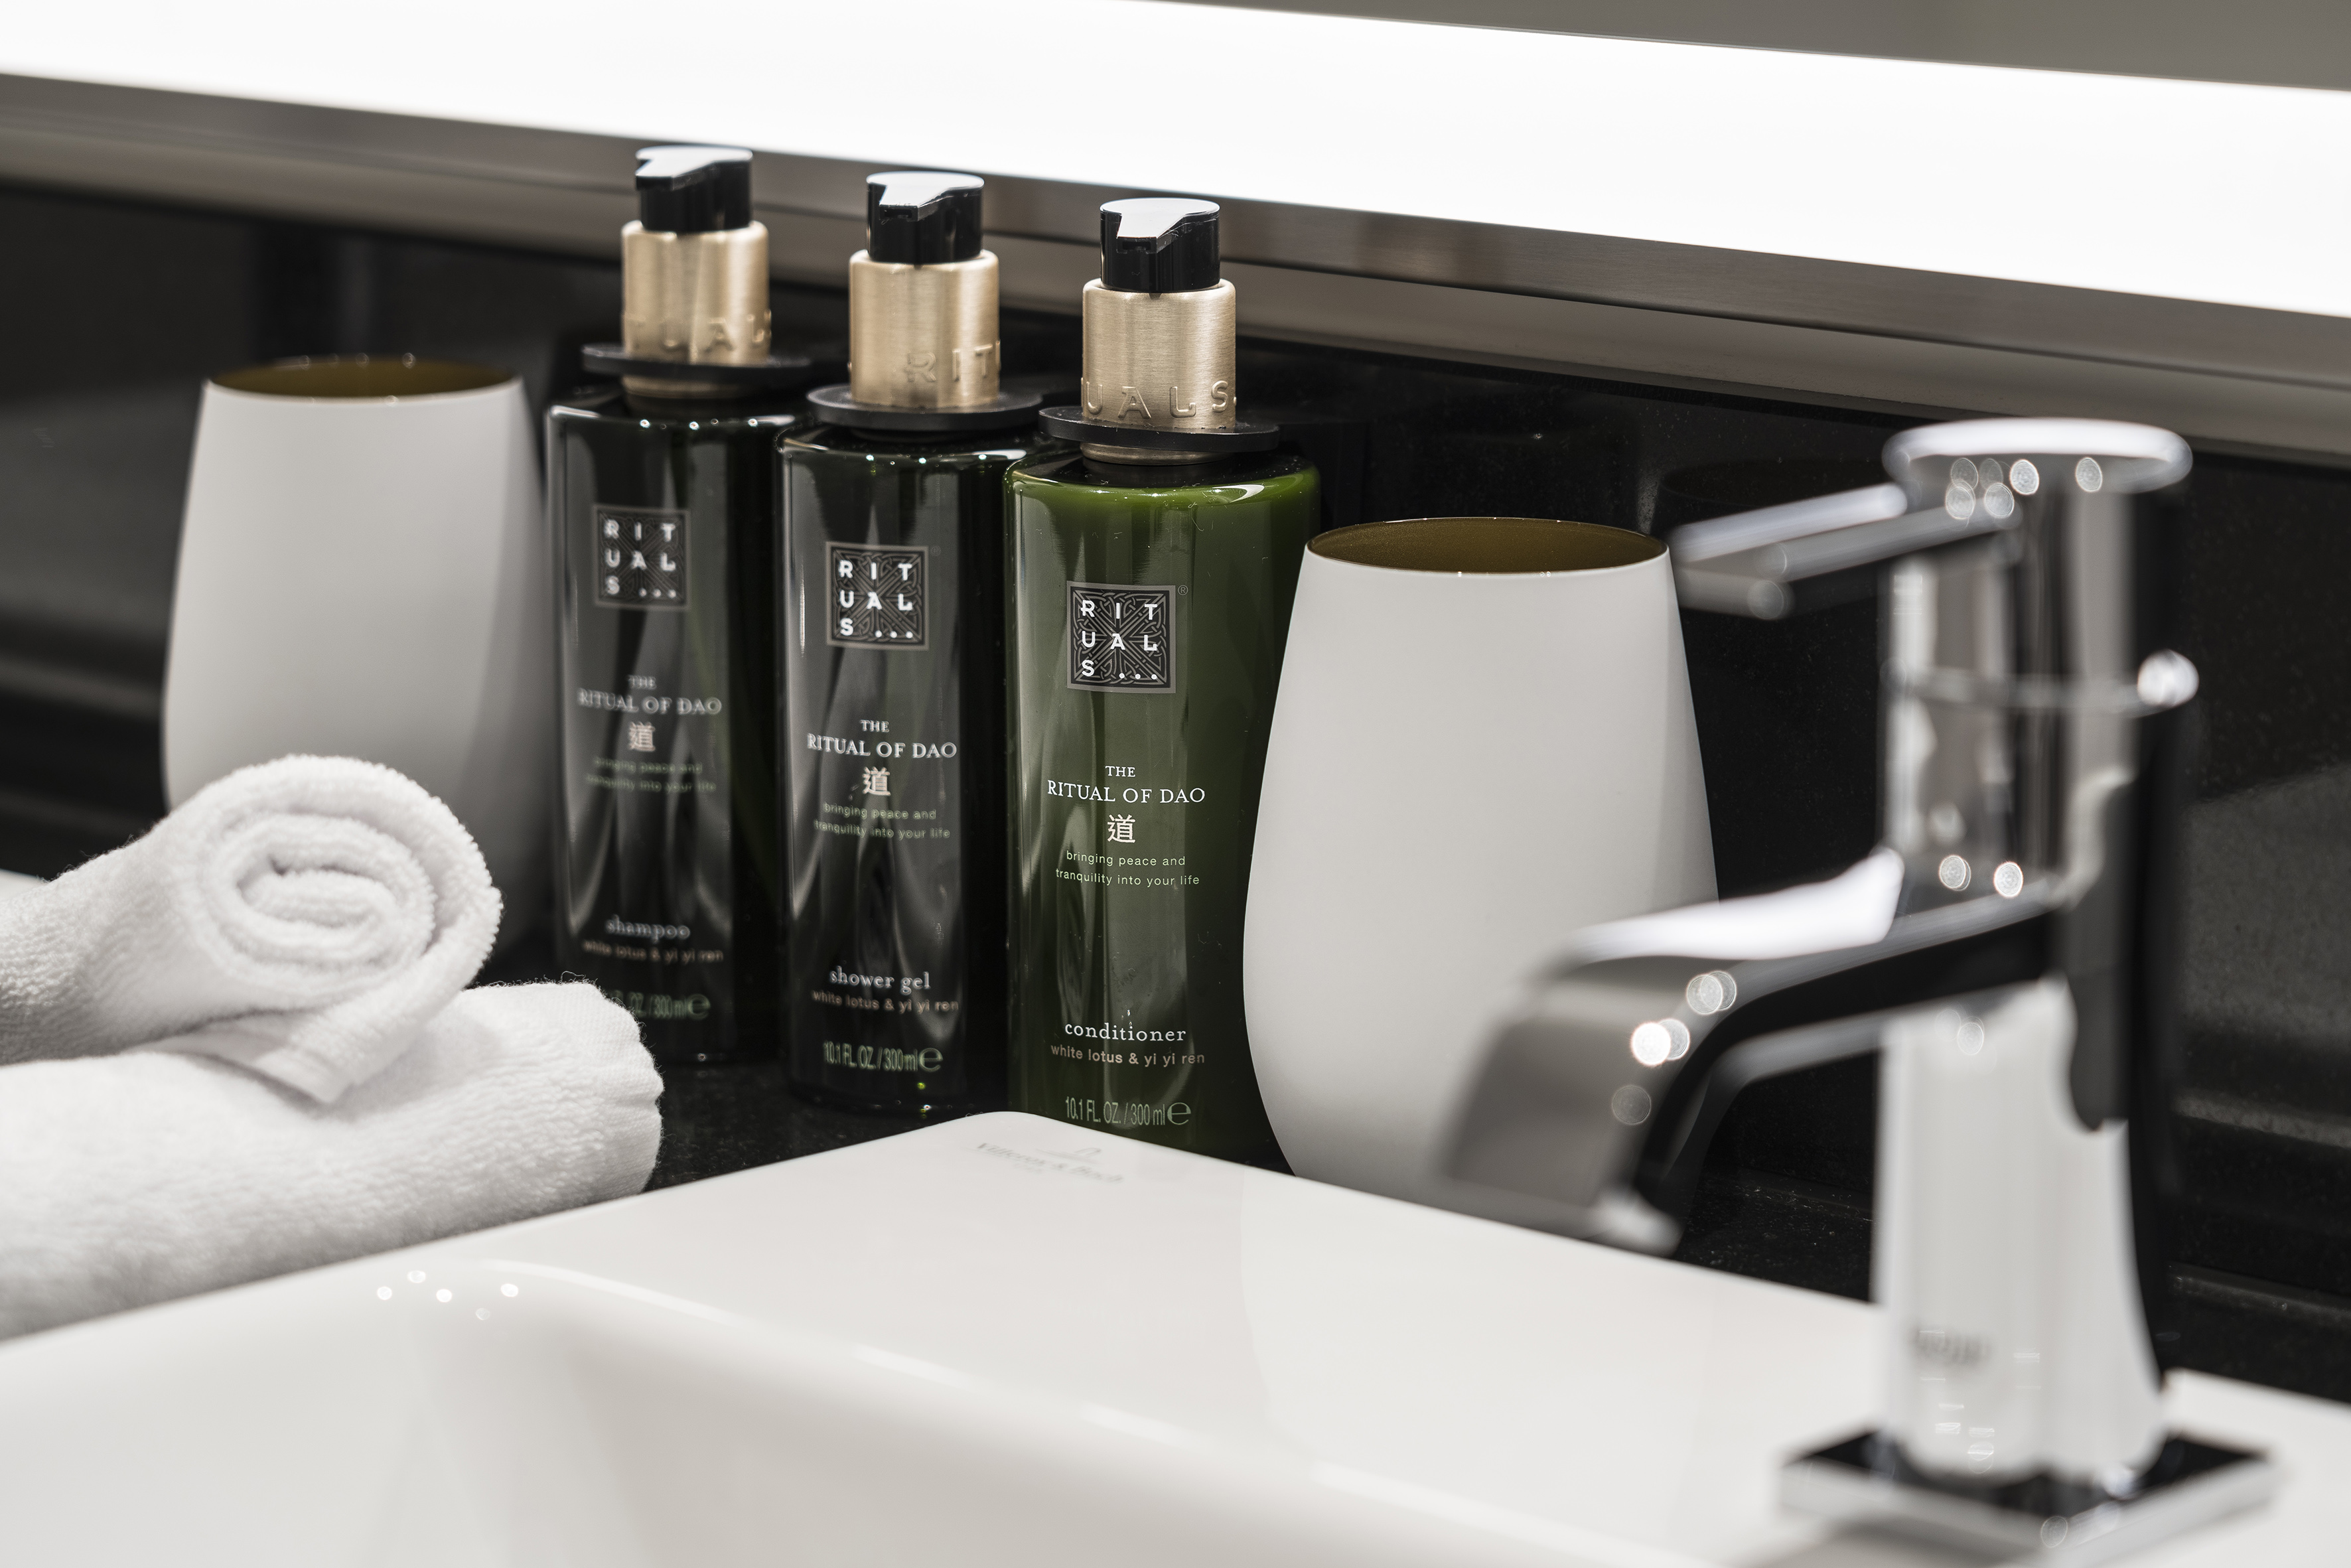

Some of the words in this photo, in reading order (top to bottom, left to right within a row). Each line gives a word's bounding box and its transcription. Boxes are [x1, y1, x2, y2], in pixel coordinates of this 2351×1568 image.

[905, 341, 1002, 384] RIT
[628, 674, 657, 689] THE
[578, 687, 638, 713] RITUAL
[642, 695, 672, 715] OF
[677, 697, 723, 715] DAO
[628, 721, 656, 752] 道
[860, 719, 890, 733] THE
[807, 733, 871, 756] RITUAL
[876, 742, 906, 758] OF
[912, 742, 958, 758] DAO
[862, 766, 891, 796] 道
[1105, 765, 1136, 778] THE
[1047, 779, 1116, 802] RITUAL
[1122, 788, 1152, 804] OF
[1159, 787, 1206, 804] DAO
[823, 802, 868, 820] bringing
[872, 808, 909, 820] peace
[913, 808, 937, 820] and
[813, 819, 867, 838] tranquility
[870, 827, 894, 839] into
[898, 828, 926, 841] your
[930, 827, 951, 839] life
[1107, 814, 1136, 844] 道
[1066, 850, 1113, 867] bringing
[1118, 856, 1157, 867] peace
[1161, 855, 1186, 867] and
[1055, 868, 1112, 887] tranquility
[1117, 875, 1142, 886] into
[1146, 876, 1175, 888] your
[1179, 875, 1200, 885] life
[605, 914, 691, 944] shampoo
[829, 965, 895, 989] shower
[900, 971, 932, 995] gel
[812, 989, 843, 1006] white
[846, 993, 881, 1011] lotus
[883, 998, 894, 1011] &
[898, 999, 912, 1014] yi
[916, 1000, 931, 1014] yi
[934, 1001, 960, 1012] ren
[1065, 1022, 1186, 1042] conditioner
[1050, 1044, 1084, 1060] white
[1088, 1049, 1123, 1064] lotus
[1128, 1052, 1139, 1064] &
[1144, 1053, 1157, 1067] yi
[1163, 1054, 1175, 1068] yi
[1181, 1054, 1205, 1064] ren
[1065, 1096, 1084, 1120] 10.1
[1086, 1099, 1102, 1123] FL.
[1103, 1100, 1120, 1125] OZ.
